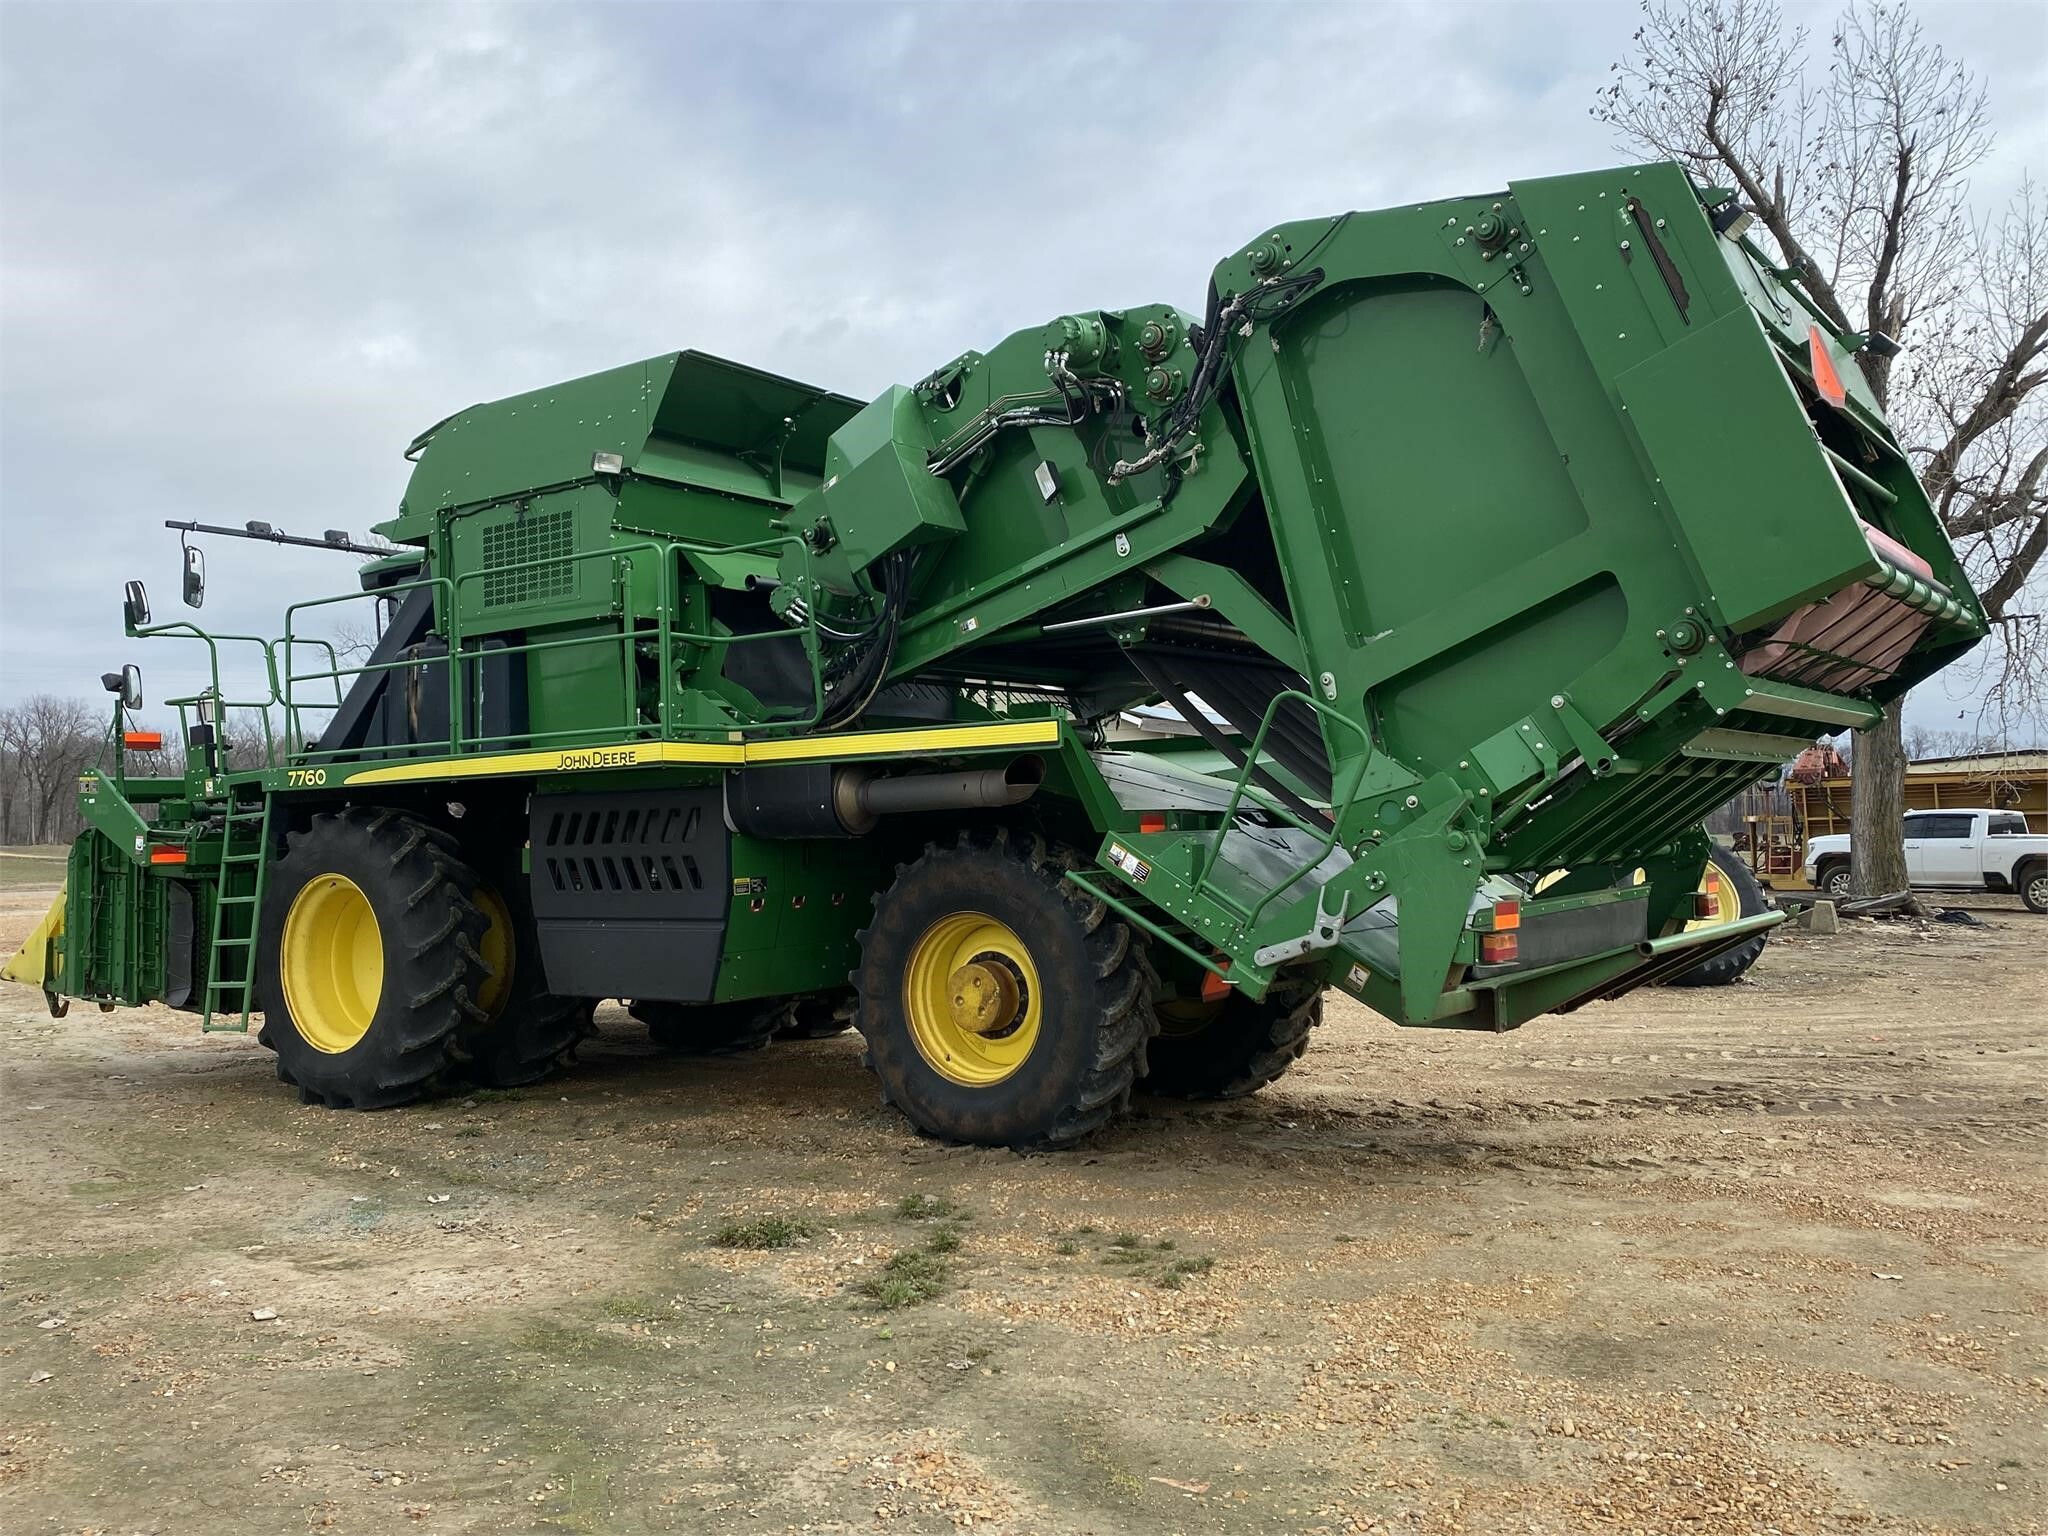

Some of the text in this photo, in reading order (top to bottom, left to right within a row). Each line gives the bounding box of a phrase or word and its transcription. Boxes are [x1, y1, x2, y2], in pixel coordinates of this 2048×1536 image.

[557, 751, 637, 769] JOHN DEERE
[287, 768, 327, 787] 7760
